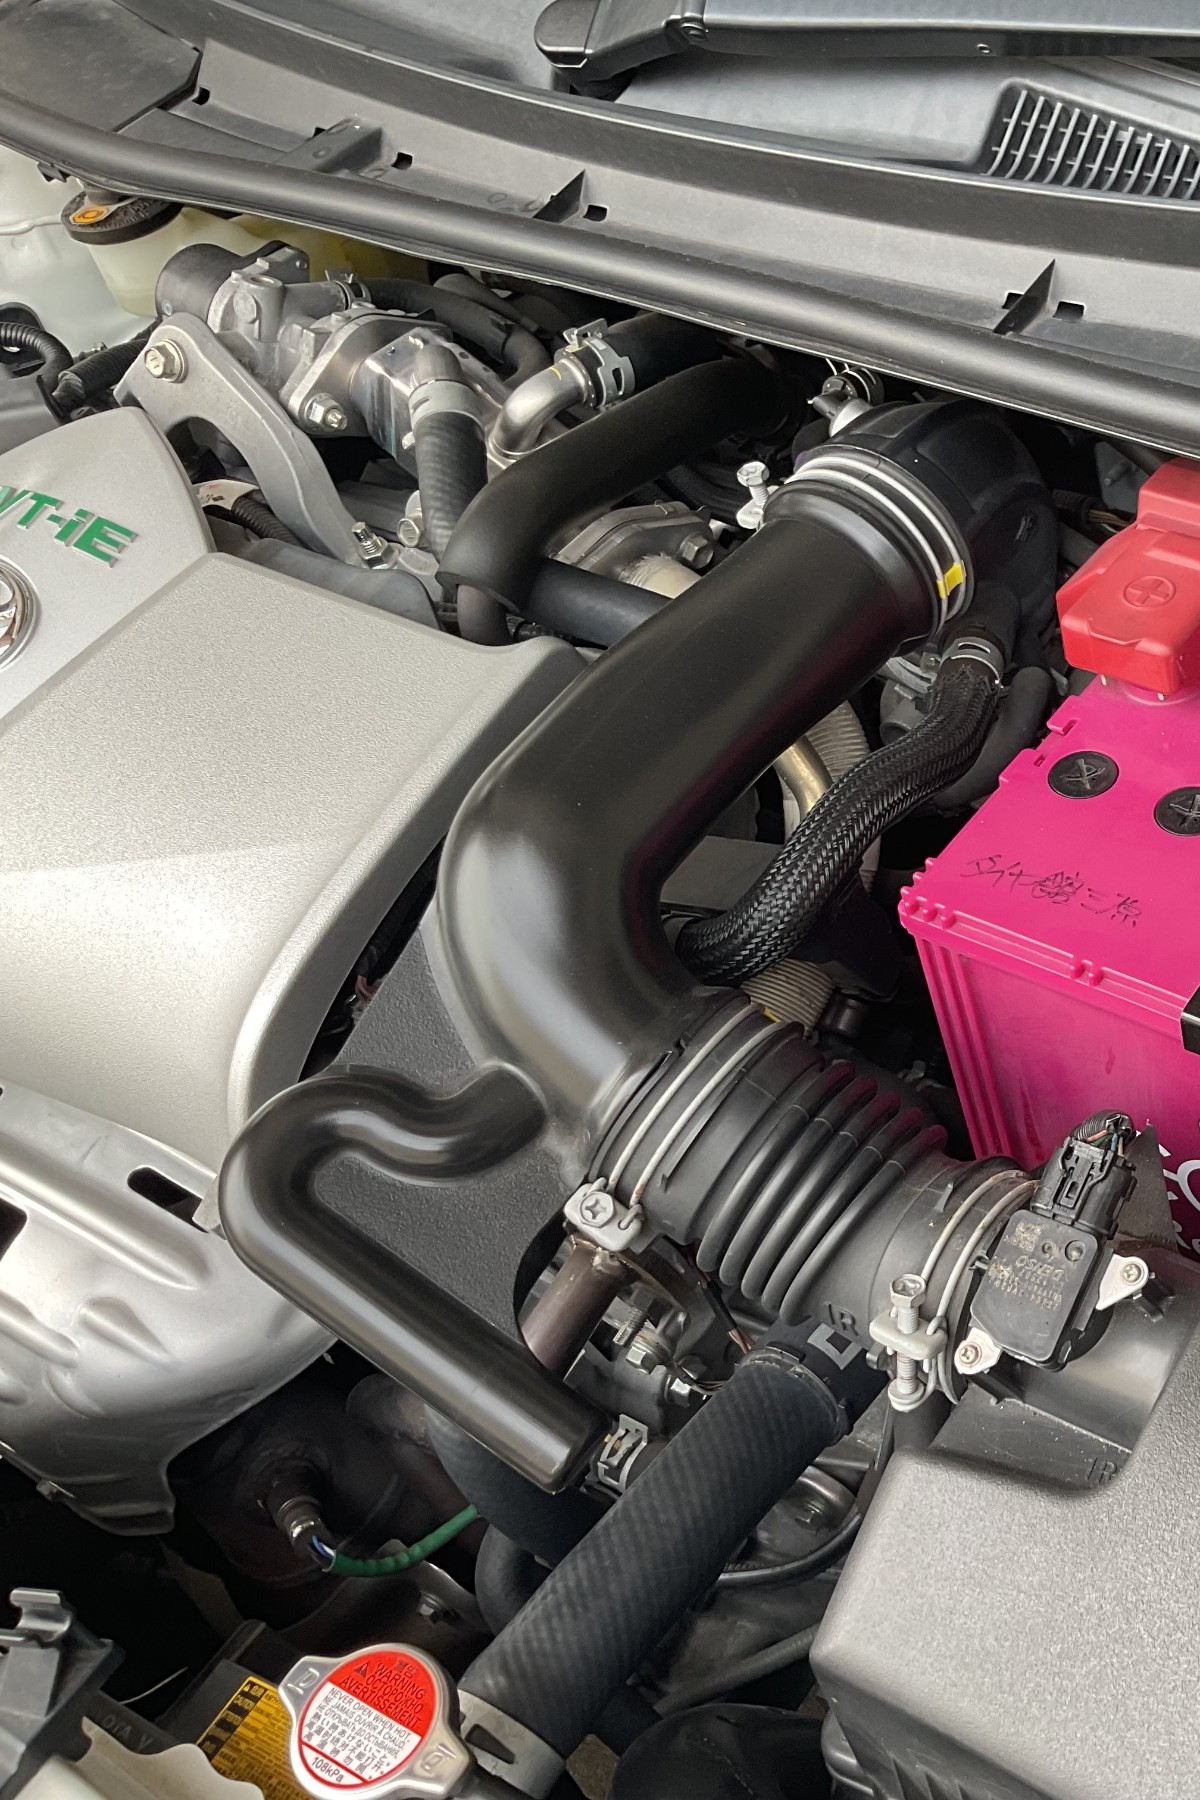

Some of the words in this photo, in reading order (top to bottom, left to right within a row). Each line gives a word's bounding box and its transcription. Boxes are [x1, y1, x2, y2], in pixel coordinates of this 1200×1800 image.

[1015, 1255, 1065, 1282] DENSO
[366, 1674, 424, 1715] ОСТОРОЖНО
[375, 1663, 427, 1700] WARNING
[316, 1703, 324, 1713] НЕ
[324, 1708, 356, 1734] ОТКРЫВАТЬ
[323, 1695, 332, 1705] NE
[331, 1700, 355, 1720] JAMAIS
[354, 1713, 379, 1731] OUVRIR
[328, 1687, 352, 1705] NEVER
[352, 1701, 373, 1719] OPEN
[373, 1713, 395, 1731] WHEN
[394, 1726, 412, 1743] HOT.
[338, 1675, 423, 1728] AVERTISSEMENT
[311, 1755, 345, 1783] 108kPa
